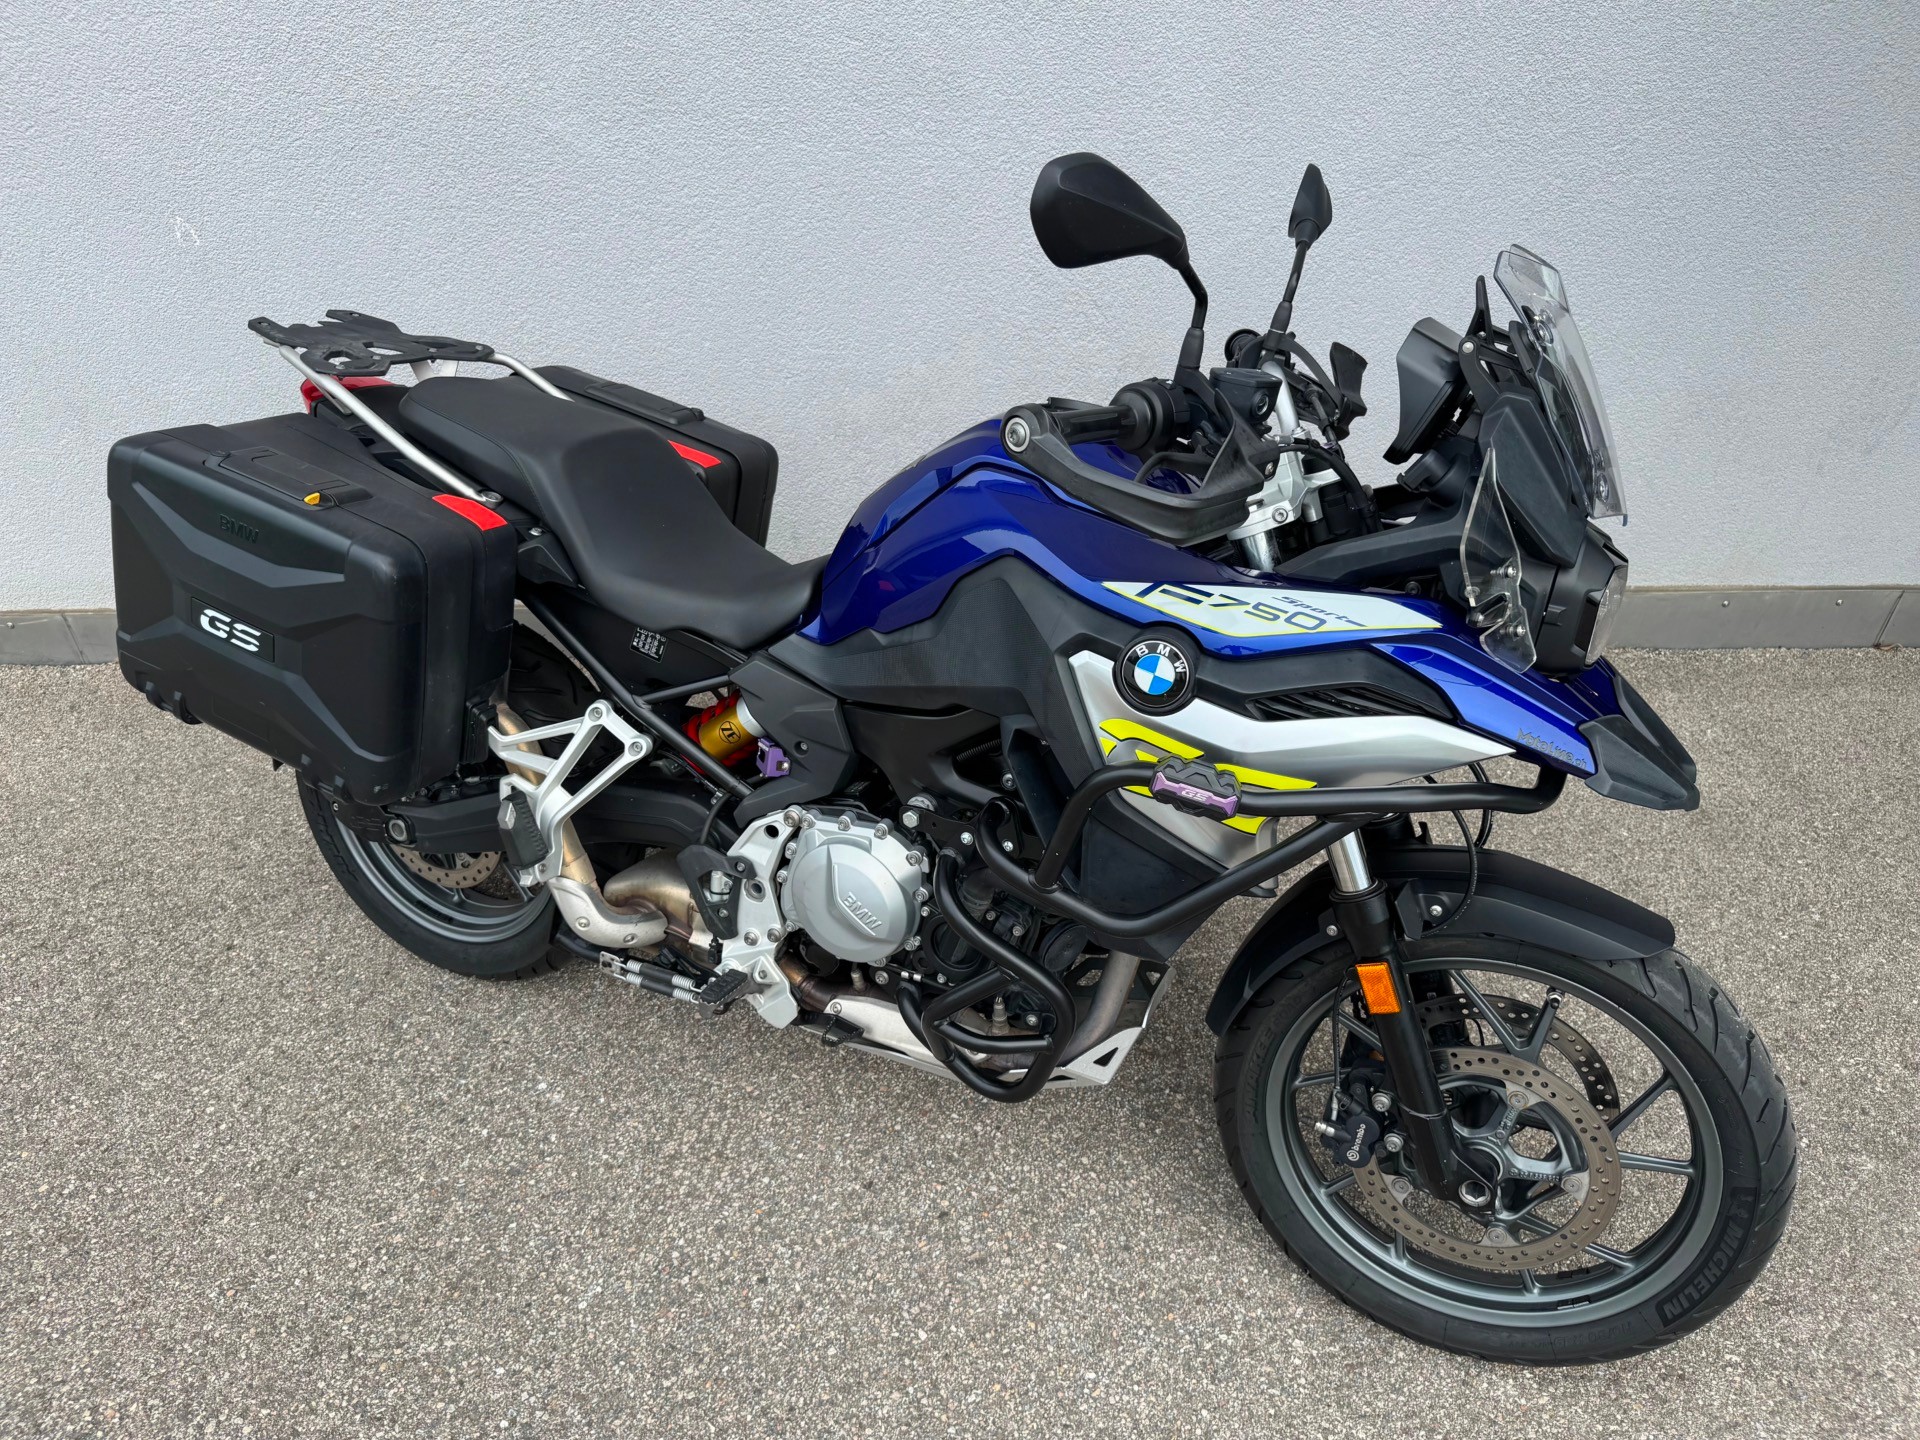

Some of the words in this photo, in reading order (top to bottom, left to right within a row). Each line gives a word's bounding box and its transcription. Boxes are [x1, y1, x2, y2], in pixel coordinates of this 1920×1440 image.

[220, 513, 259, 544] BMW
[1136, 582, 1328, 631] F750
[1274, 595, 1360, 627] Sport
[200, 608, 262, 652] GS
[1135, 643, 1188, 673] BMW
[719, 721, 741, 744] ZF
[1181, 788, 1209, 802] GS
[843, 891, 882, 930] BMW
[1350, 1122, 1367, 1153] brembo
[1662, 1219, 1744, 1320] MICHELIN
